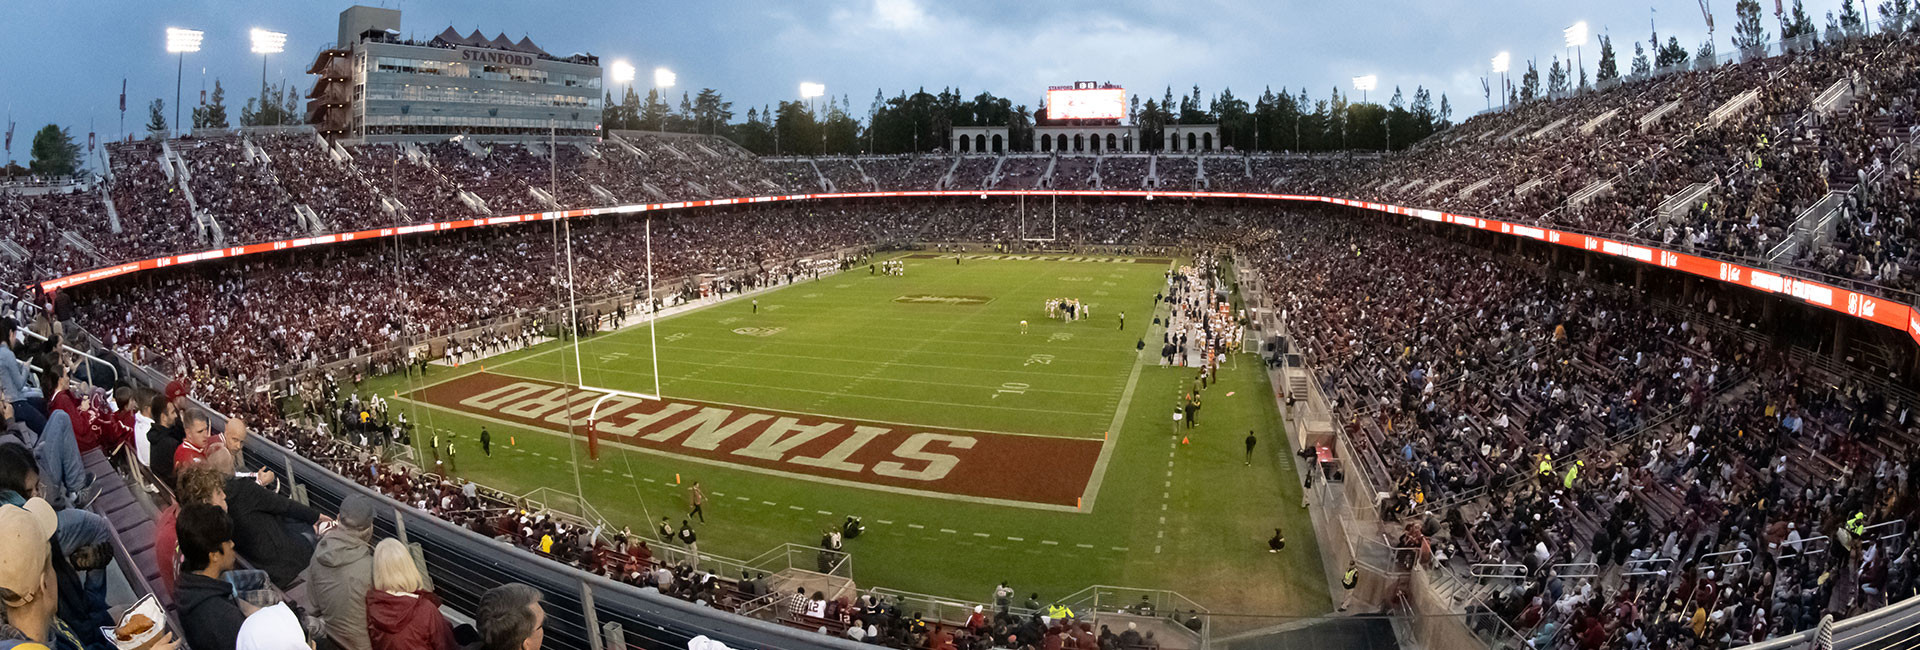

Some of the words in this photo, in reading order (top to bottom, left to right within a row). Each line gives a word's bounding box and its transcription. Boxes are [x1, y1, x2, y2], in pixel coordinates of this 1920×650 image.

[462, 49, 533, 66] STANFORD
[997, 382, 1030, 395] 10
[459, 381, 978, 482] STANFORD
[809, 601, 819, 613] 12
[839, 613, 851, 625] 12
